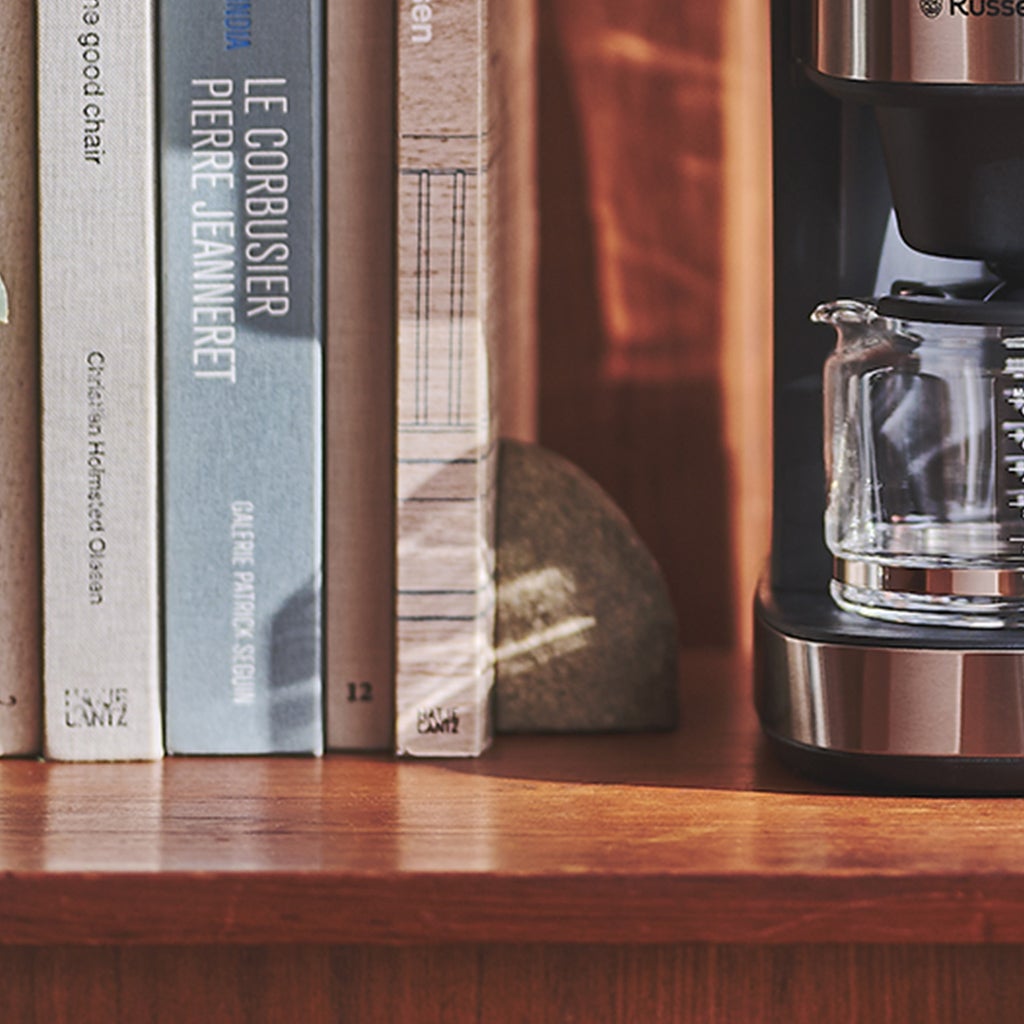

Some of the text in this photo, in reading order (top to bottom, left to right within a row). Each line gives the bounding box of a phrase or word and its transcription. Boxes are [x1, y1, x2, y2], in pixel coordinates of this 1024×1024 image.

[78, 32, 104, 96] good
[83, 103, 105, 165] chair
[244, 78, 289, 318] LE CORBUSIER
[191, 79, 236, 383] PIERRE JEANNERET
[231, 500, 256, 704] GALERIE PATRICK SEGUIN
[347, 681, 373, 703] 12
